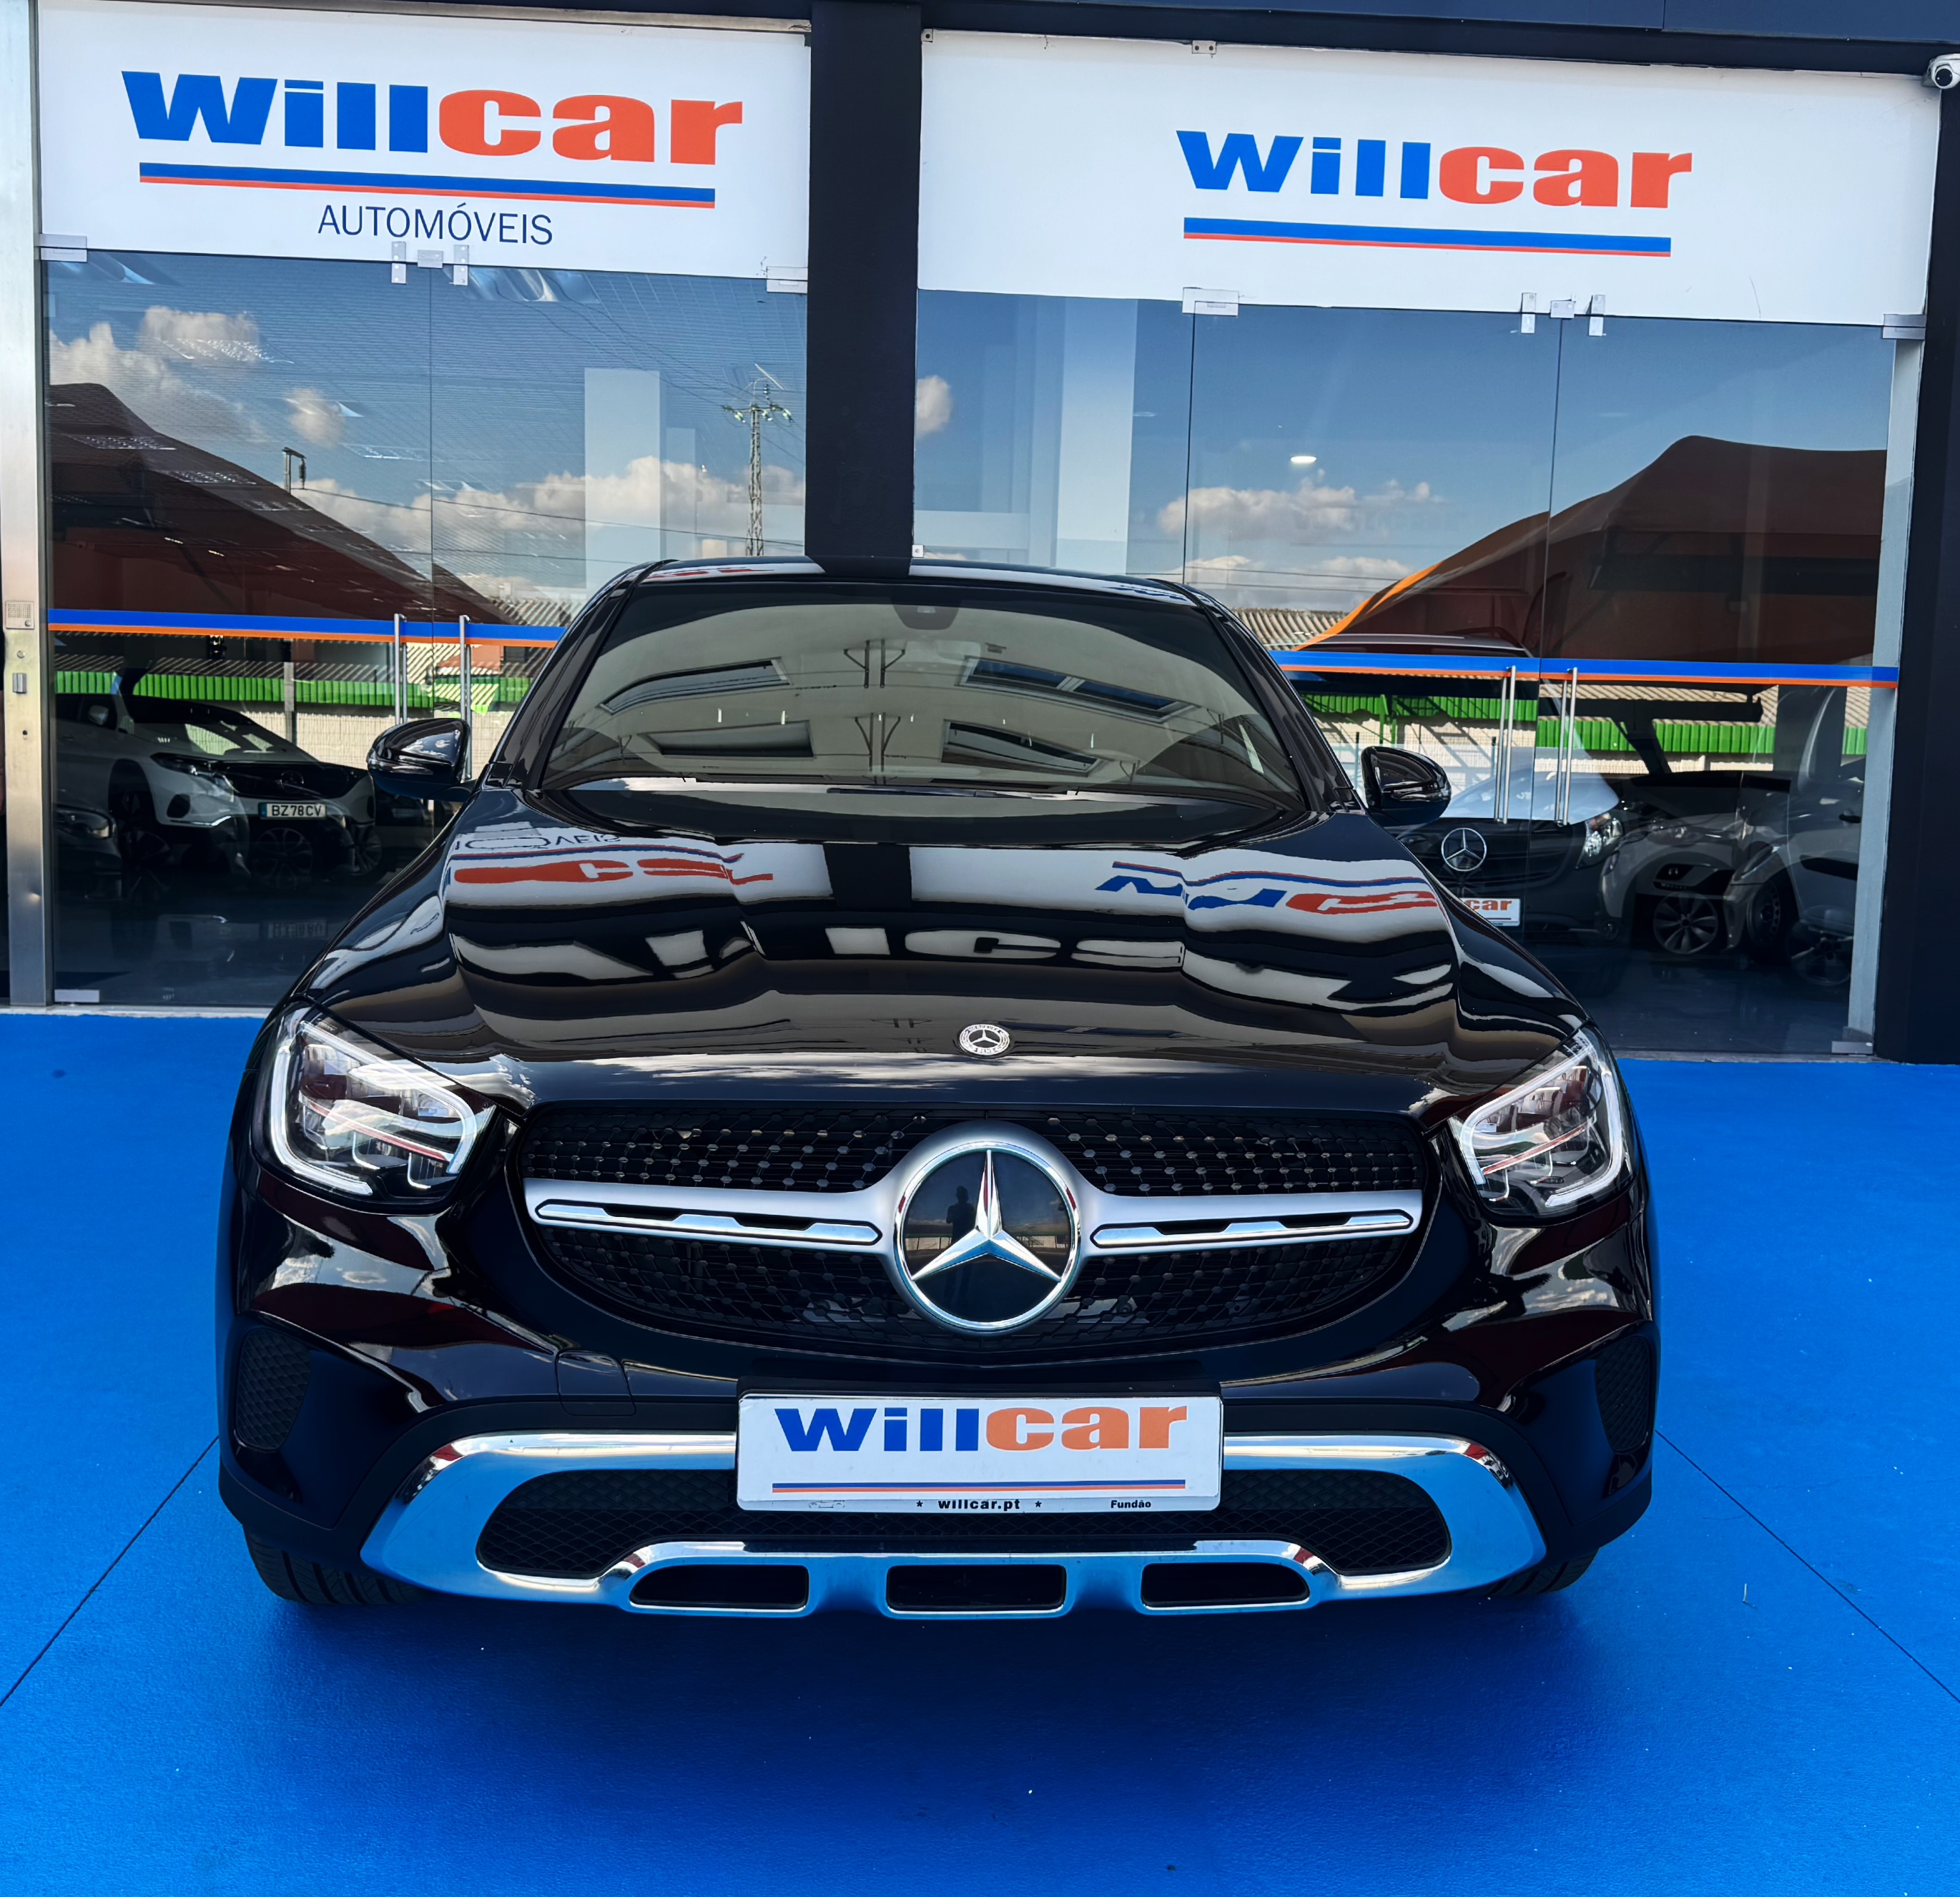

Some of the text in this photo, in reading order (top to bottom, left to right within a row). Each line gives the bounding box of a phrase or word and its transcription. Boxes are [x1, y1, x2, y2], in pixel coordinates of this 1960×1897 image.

[318, 202, 553, 245] AUTOMÓVEIS
[937, 1499, 1151, 1512] willcar.pt Fundão
